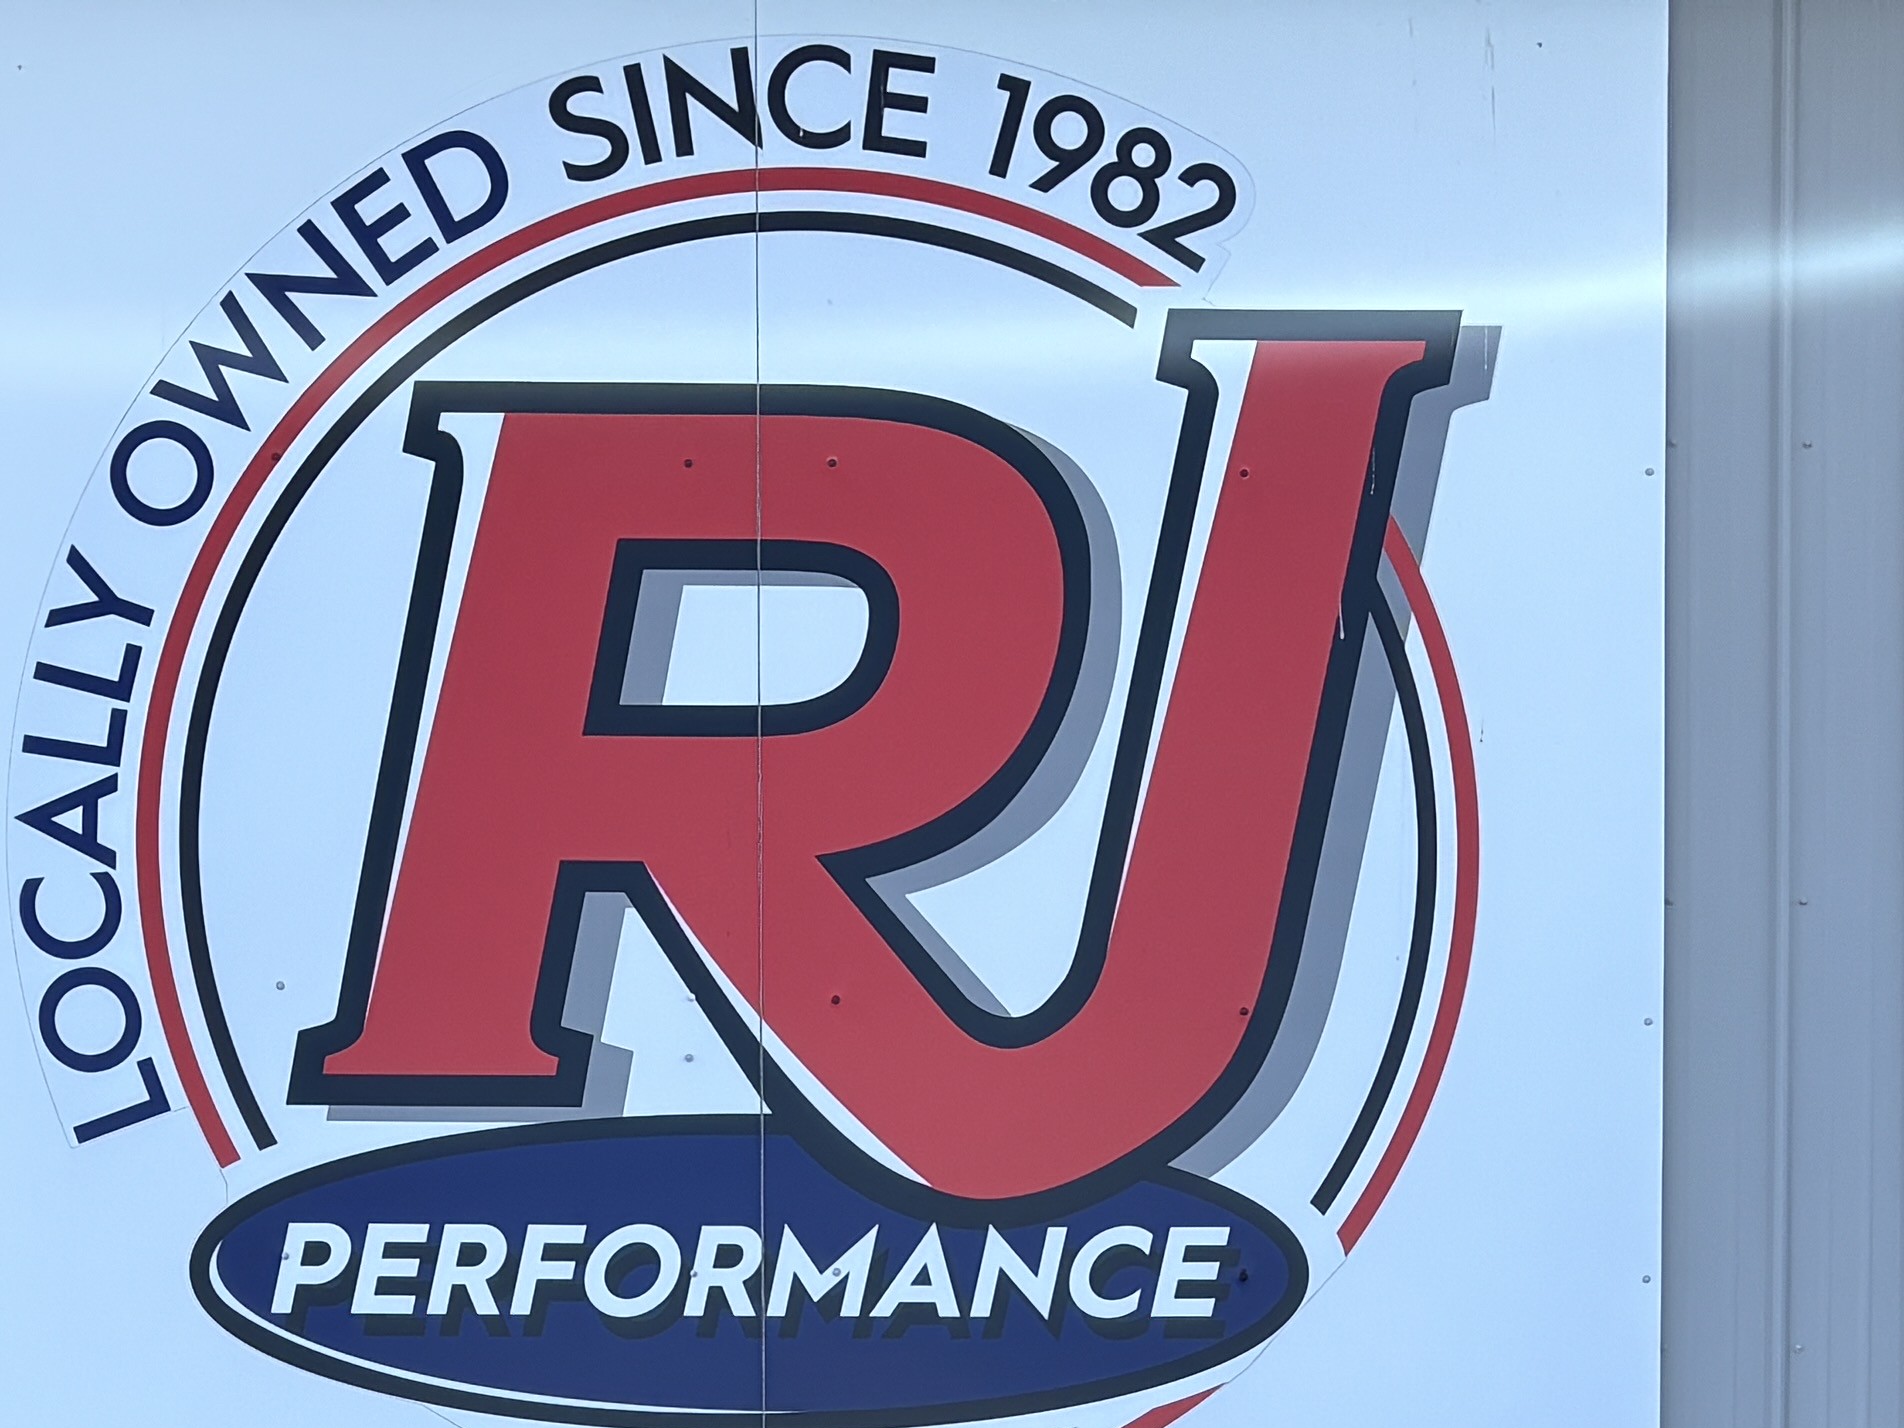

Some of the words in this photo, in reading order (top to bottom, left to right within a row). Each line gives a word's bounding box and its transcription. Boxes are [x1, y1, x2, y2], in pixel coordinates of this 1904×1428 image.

[14, 543, 172, 1145] LOCALLY
[109, 129, 510, 527] OWNED
[547, 43, 937, 182] SINCE
[987, 72, 1237, 274] 1982
[286, 307, 1464, 1231] RJ
[268, 1222, 1229, 1321] PERFORMANCE
